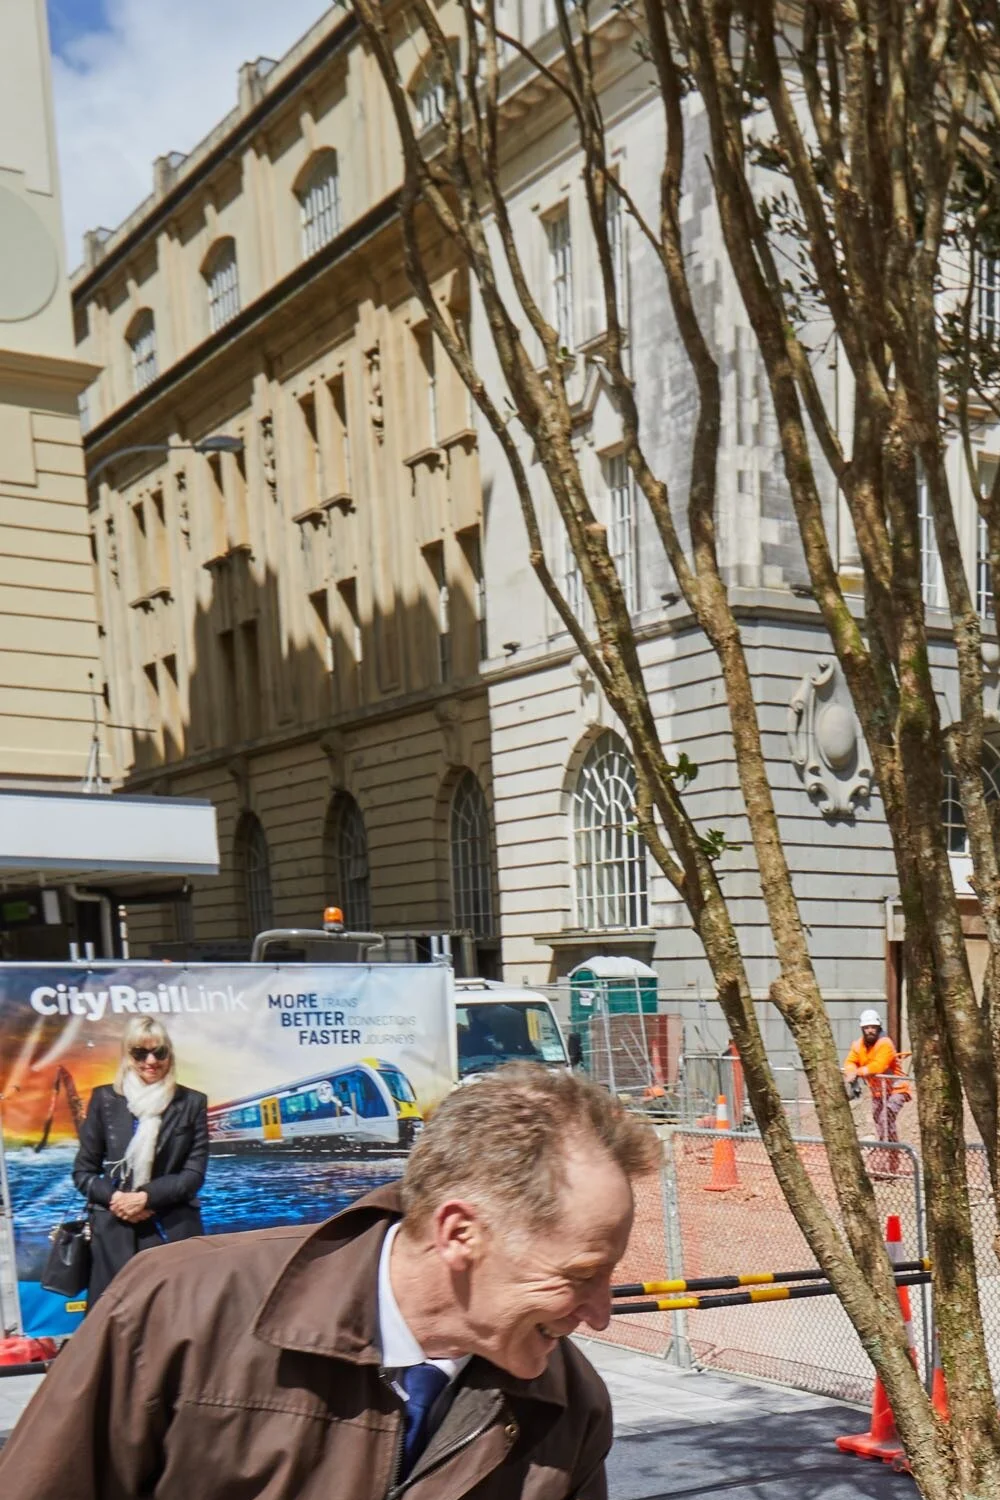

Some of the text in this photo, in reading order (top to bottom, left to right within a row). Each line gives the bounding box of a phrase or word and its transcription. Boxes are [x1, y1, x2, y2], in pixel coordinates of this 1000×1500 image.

[268, 993, 359, 1009] MORE TRAINS
[281, 1011, 416, 1027] BETTER CONNECTIONS
[299, 1030, 416, 1045] FASTER JOURNEYS
